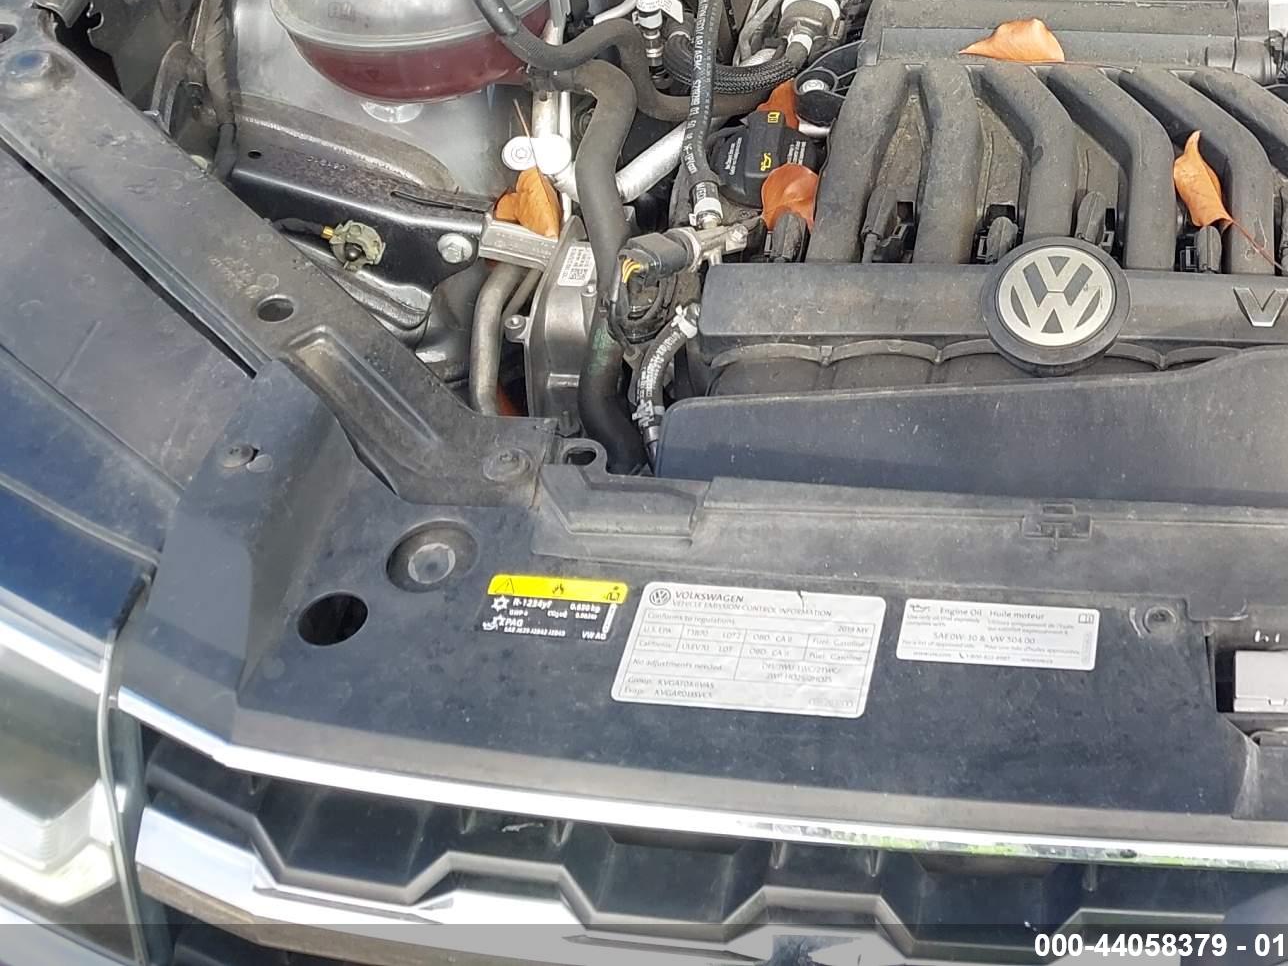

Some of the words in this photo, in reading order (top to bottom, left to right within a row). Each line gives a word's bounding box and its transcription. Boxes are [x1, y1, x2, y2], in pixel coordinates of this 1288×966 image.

[675, 591, 744, 603] VOLKSWAGEN
[673, 601, 702, 609] VEHICLE
[704, 603, 740, 611] EMISSION
[741, 605, 776, 614] CONTROL
[778, 608, 831, 617] INFORMATION
[940, 608, 968, 617] Engine
[970, 609, 982, 617] Oil
[990, 610, 1012, 618] Huile
[1013, 612, 1044, 620] moteur
